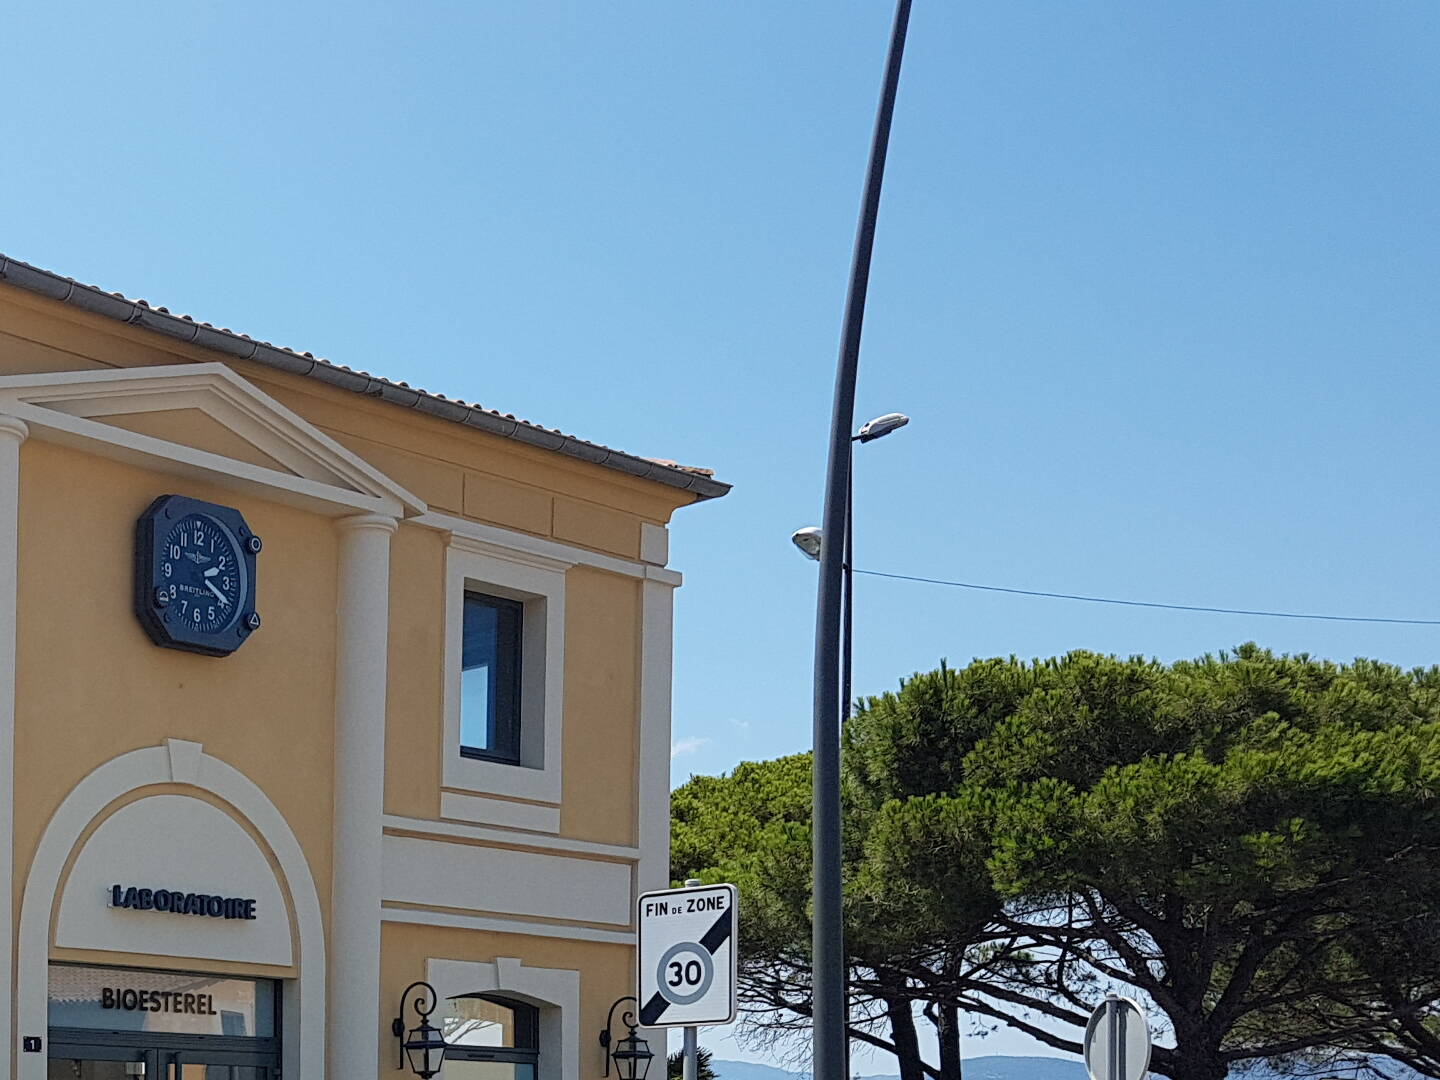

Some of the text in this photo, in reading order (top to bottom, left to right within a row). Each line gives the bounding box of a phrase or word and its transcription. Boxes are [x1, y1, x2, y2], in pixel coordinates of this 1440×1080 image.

[180, 532, 188, 547] 11
[193, 530, 204, 546] 12
[169, 545, 181, 560] 10
[164, 562, 172, 577] 9
[218, 556, 226, 570] 2
[222, 576, 230, 590] 3
[169, 584, 177, 599] 8
[181, 600, 188, 614] 7
[207, 606, 215, 621] 5
[193, 608, 201, 623] 6
[111, 884, 257, 920] LABORATOIRE
[646, 896, 725, 917] FIN DE ZONE
[668, 960, 702, 987] 30
[100, 986, 218, 1016] BIOESTEREL
